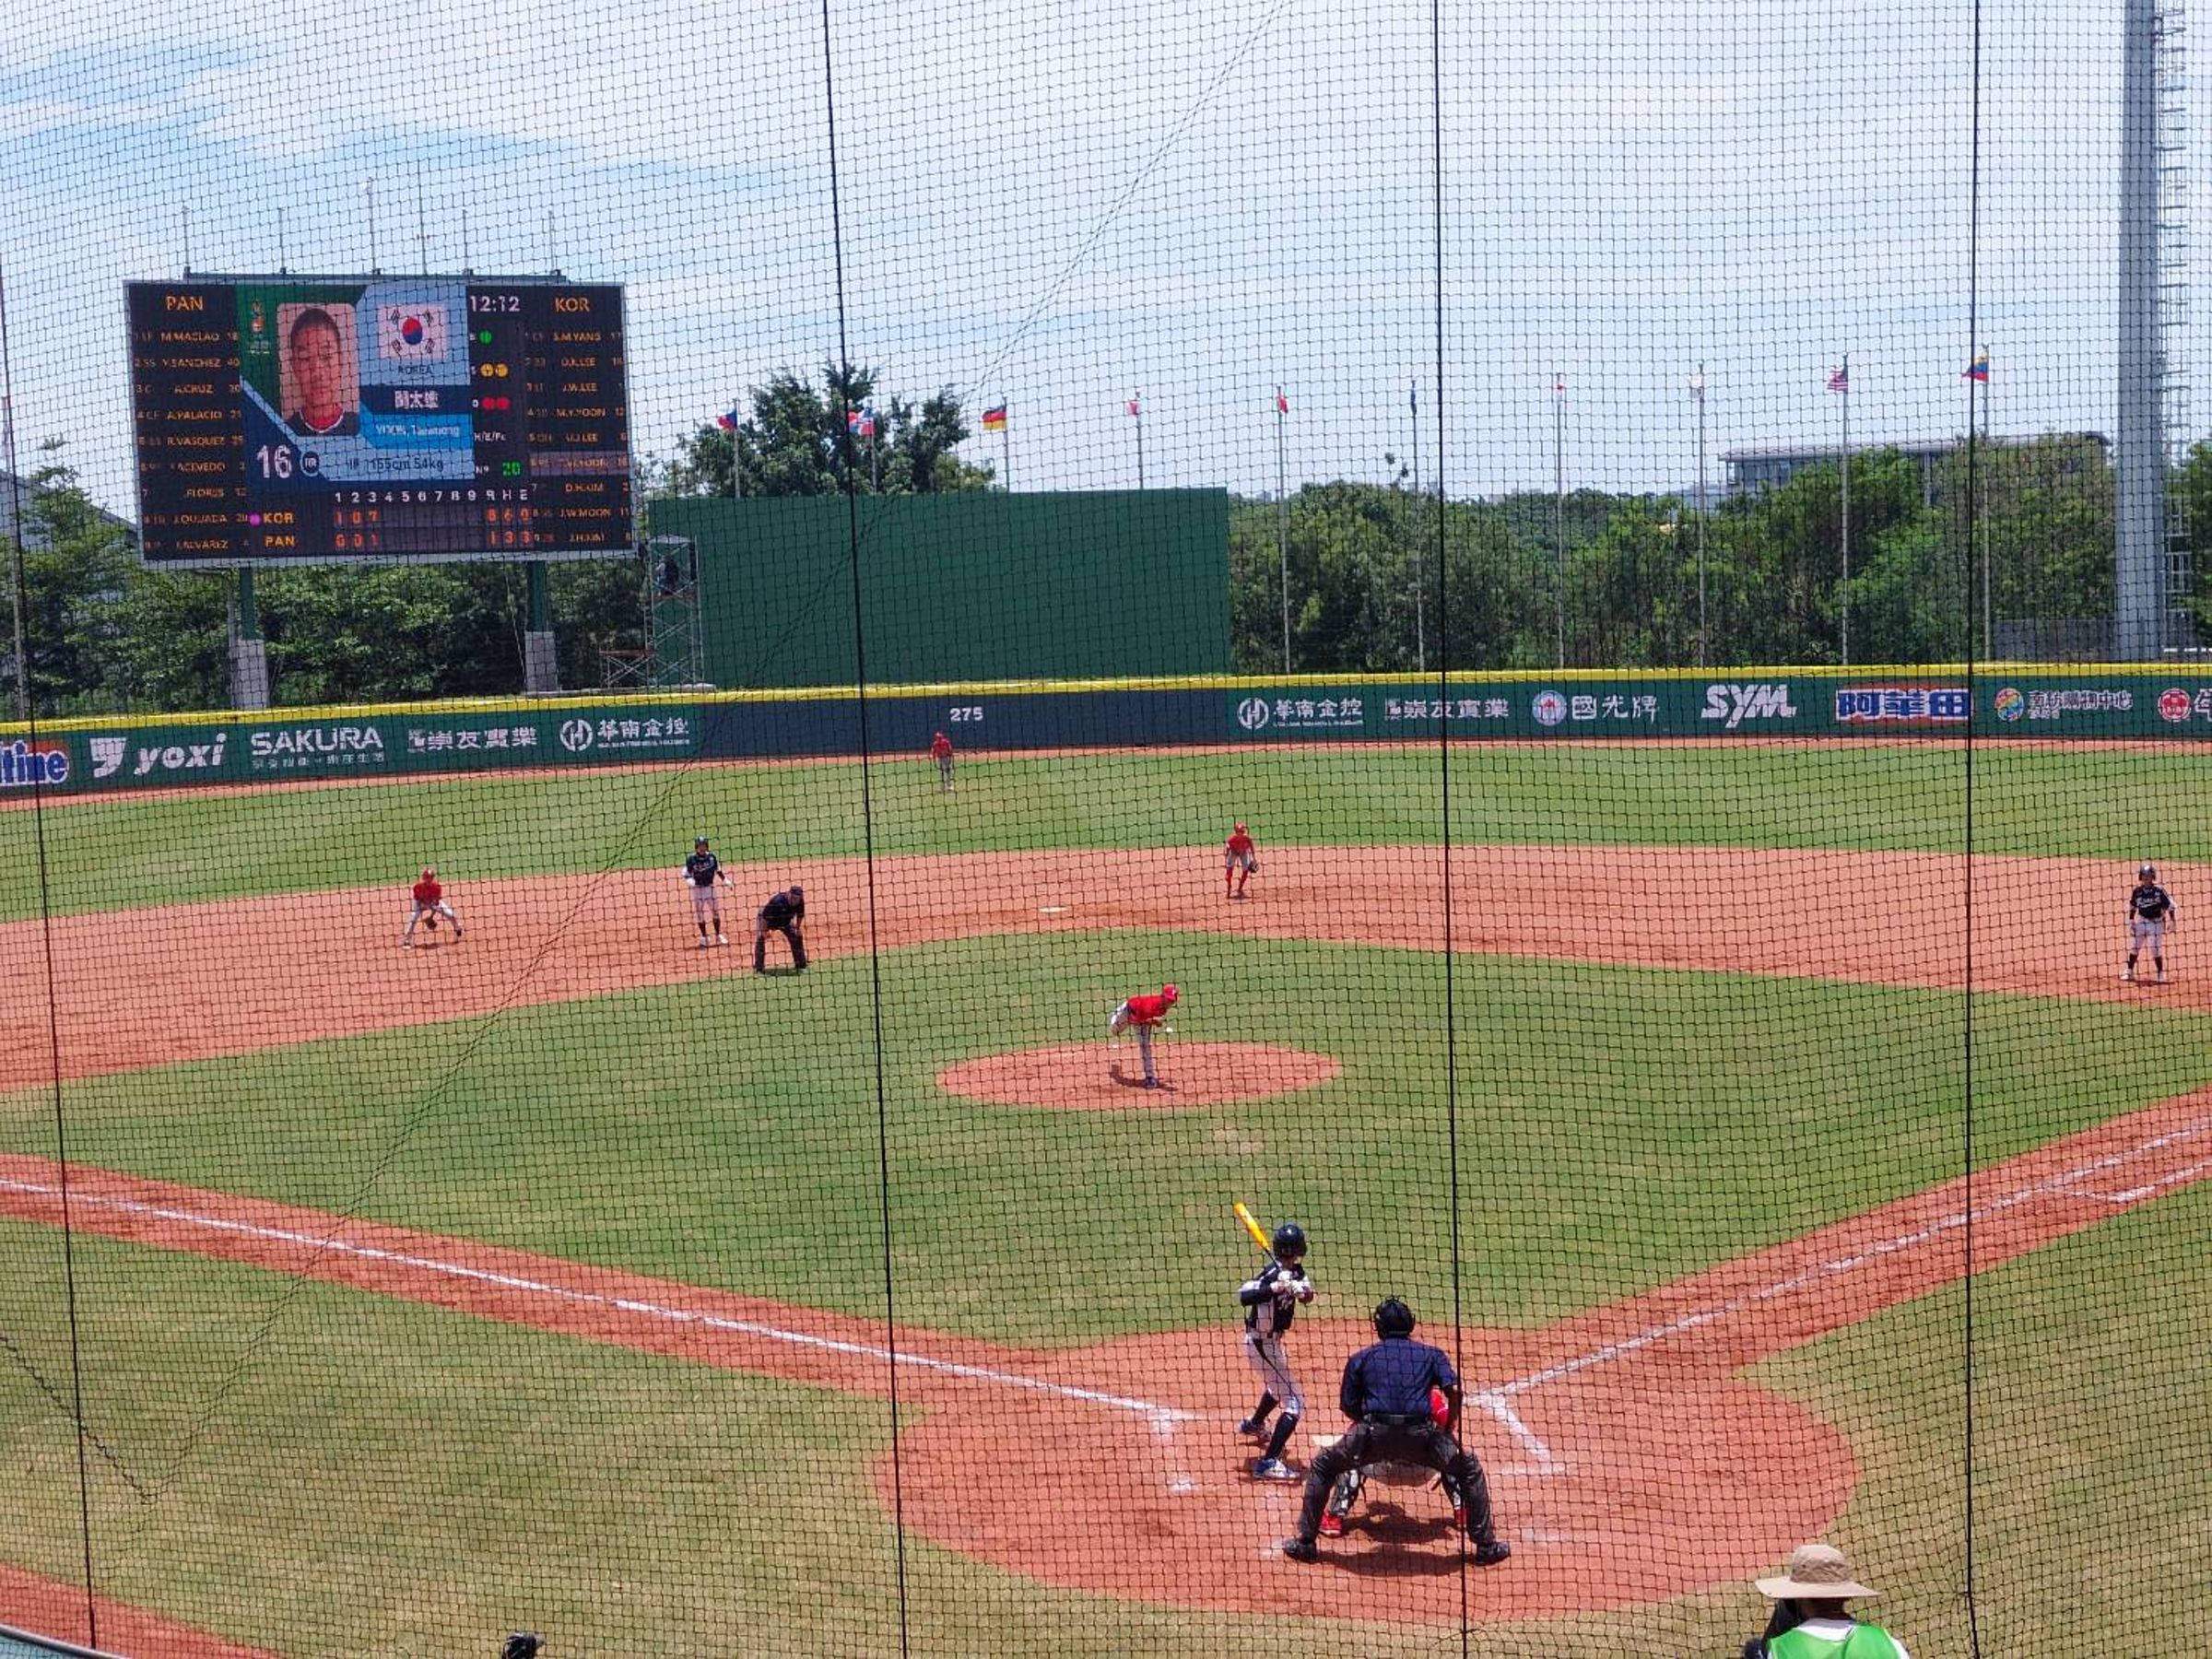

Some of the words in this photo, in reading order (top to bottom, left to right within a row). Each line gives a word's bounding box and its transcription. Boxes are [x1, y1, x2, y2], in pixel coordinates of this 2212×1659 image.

[166, 296, 204, 311] PAN
[470, 295, 521, 312] 12:12
[555, 298, 590, 312] KOR
[257, 445, 293, 478] 16
[502, 462, 522, 477] 20
[335, 492, 342, 502] 1
[351, 492, 359, 502] 2
[369, 491, 377, 502] 3
[384, 491, 394, 502] 4
[402, 491, 410, 502] 5
[418, 491, 427, 501] 6
[435, 491, 443, 501] 7
[467, 489, 477, 500] 9
[486, 489, 495, 500] R
[503, 489, 512, 500] H
[520, 489, 528, 500] E
[264, 512, 294, 524] KOR
[351, 511, 361, 524] 0
[370, 510, 379, 523] 7
[265, 535, 295, 547] PAN
[335, 535, 346, 547] 0
[354, 534, 363, 547] 0
[949, 706, 983, 722] 275
[1273, 698, 1363, 720] 華南金控
[1403, 698, 1509, 719] 崇友實業
[1571, 694, 1659, 724] 國光牌
[1700, 685, 1797, 728] SYM
[1836, 688, 1970, 720] 阿華田
[597, 717, 689, 740] 華南金控
[251, 726, 384, 756] SAKURA
[133, 733, 228, 776] yoxi
